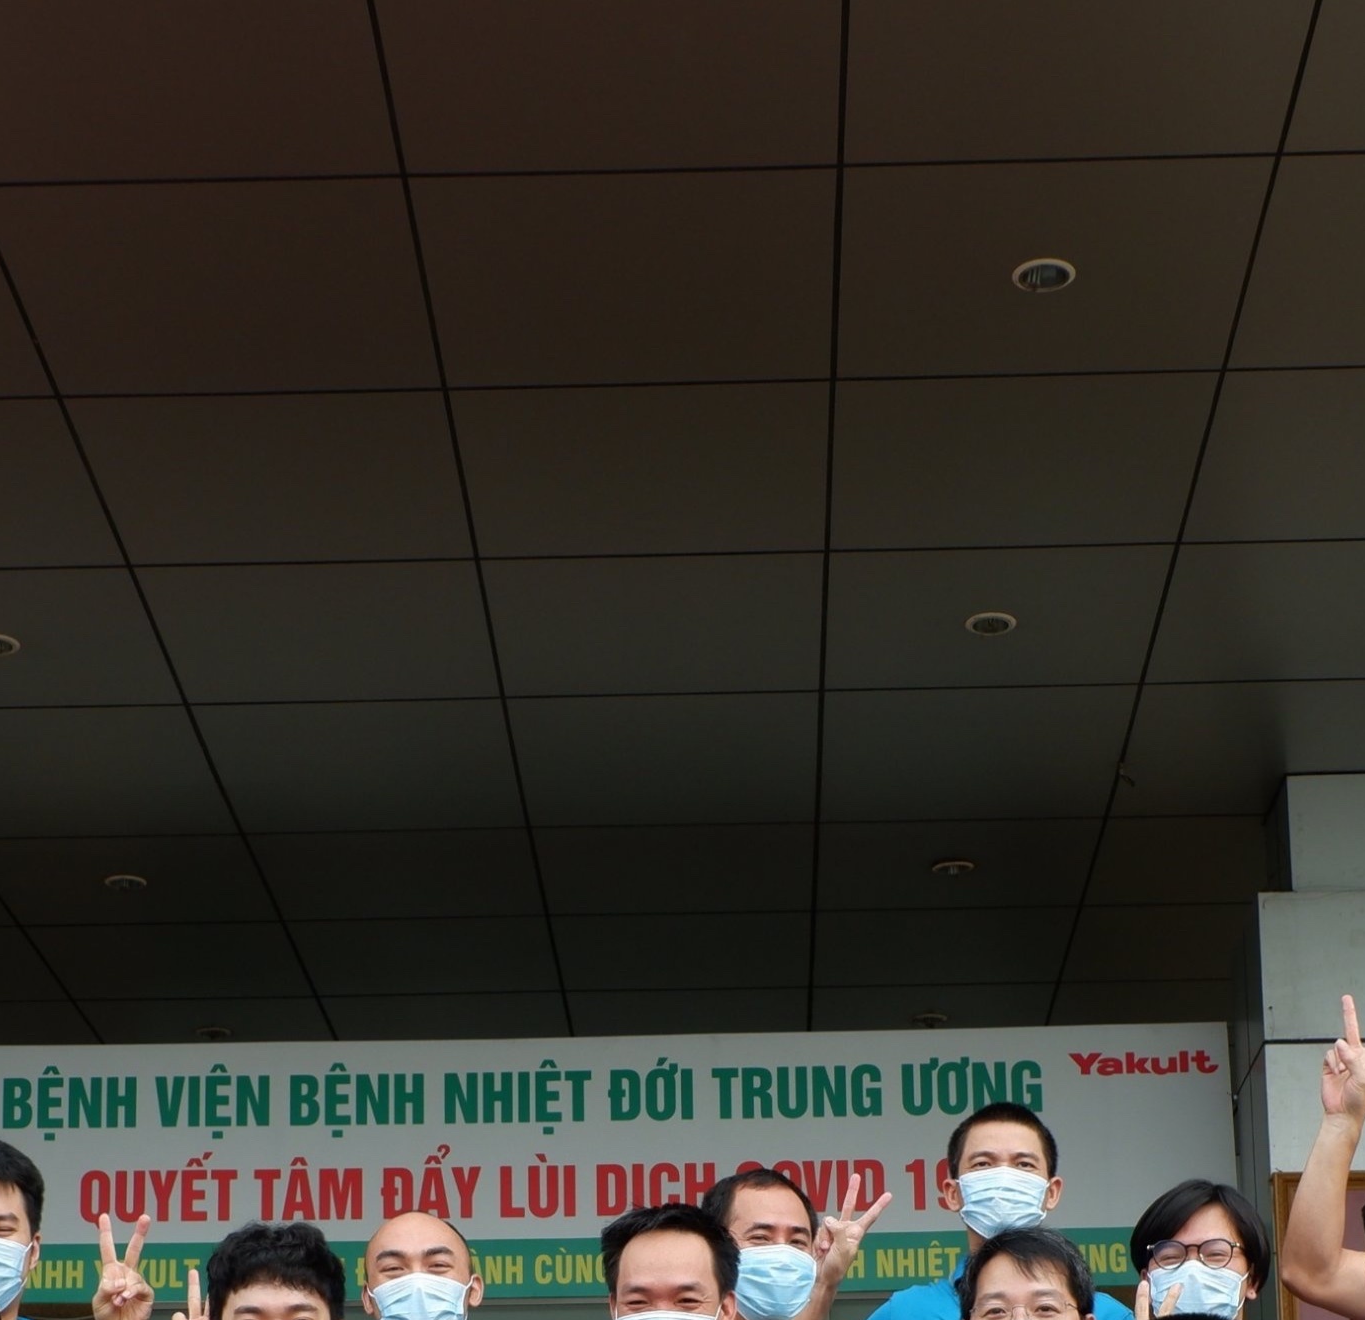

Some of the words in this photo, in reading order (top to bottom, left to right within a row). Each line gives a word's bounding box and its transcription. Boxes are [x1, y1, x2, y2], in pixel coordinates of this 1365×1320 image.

[2, 1065, 137, 1141] BỆNH
[154, 1063, 271, 1139] VIỆN
[289, 1062, 425, 1138] BỆNH
[443, 1059, 592, 1135] NHIỆT
[608, 1056, 694, 1121] ĐỚI
[711, 1063, 883, 1119] TRUNG
[901, 1056, 1043, 1116] ƯƠNG
[1068, 1050, 1220, 1076] Yakult
[80, 1152, 238, 1229] QUYẾT
[254, 1156, 363, 1221] TÂM
[380, 1143, 482, 1219] ĐẨY
[500, 1153, 577, 1218] LÙI
